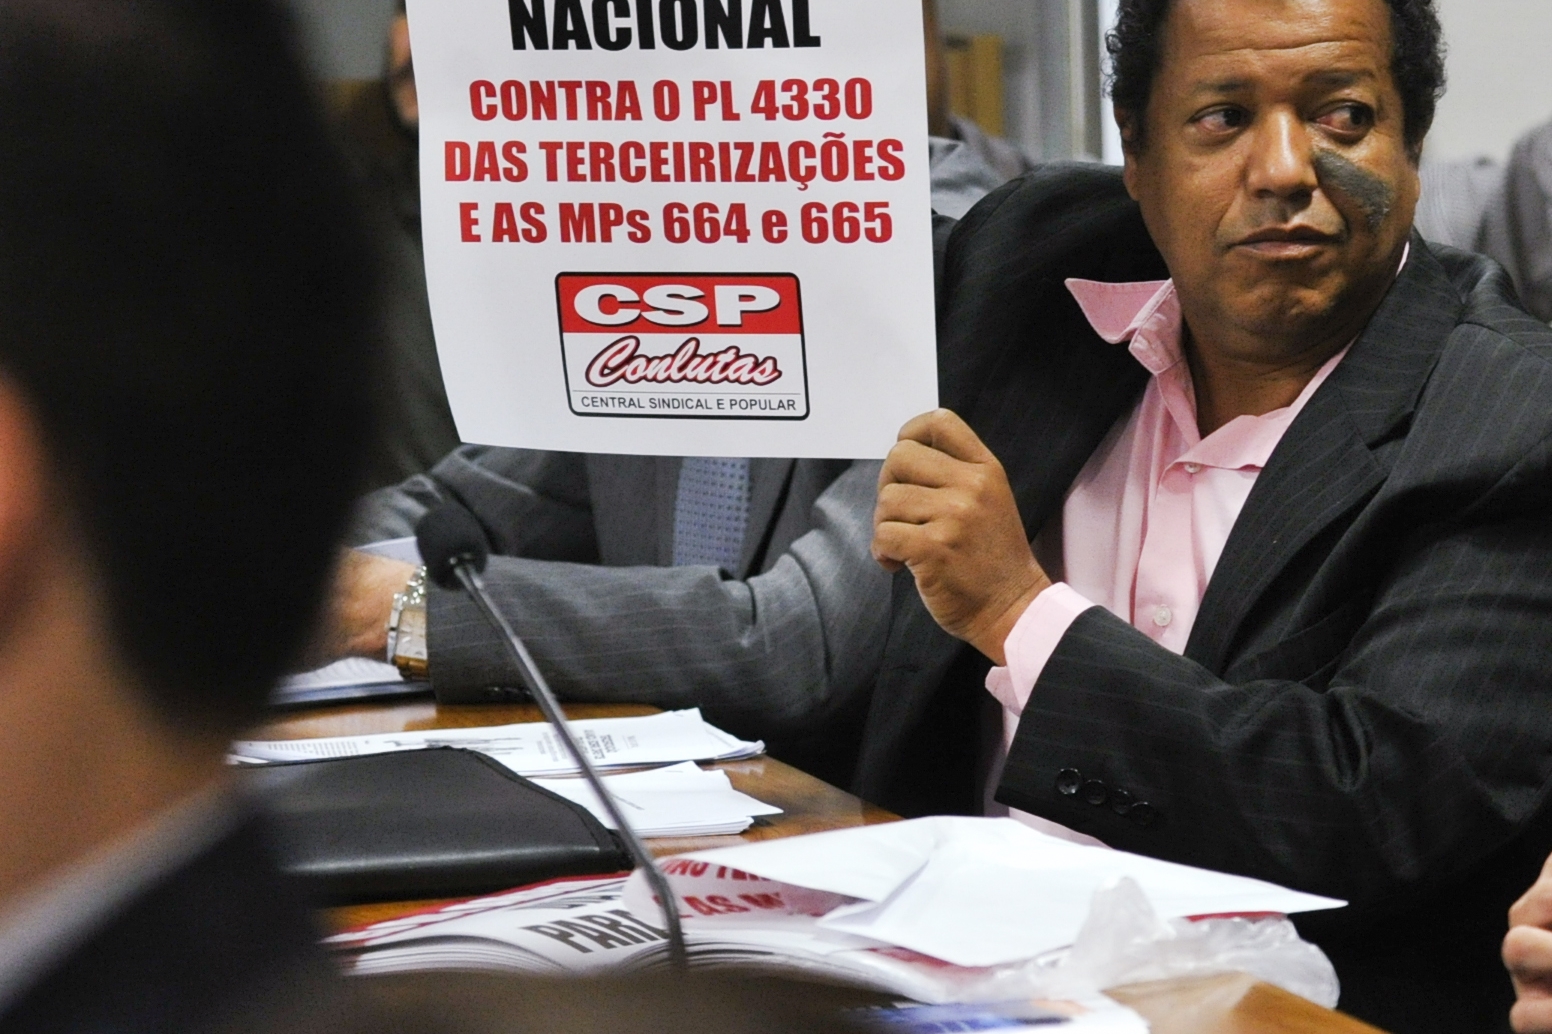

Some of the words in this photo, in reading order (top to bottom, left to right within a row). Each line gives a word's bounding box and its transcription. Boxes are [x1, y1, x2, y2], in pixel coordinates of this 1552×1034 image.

[468, 79, 643, 122] CONTRA
[652, 79, 681, 122] O
[692, 79, 741, 121] PL
[750, 76, 873, 121] 4330
[444, 139, 529, 183] DAS
[539, 131, 906, 191] TERCEIRIZAÇÕES
[459, 202, 482, 243] E
[491, 201, 547, 244] AS
[558, 202, 652, 244] MPs
[662, 201, 751, 244] 664
[761, 209, 789, 244] e
[800, 200, 893, 244] 665
[573, 283, 781, 327] CSP
[585, 335, 783, 388] Conlutas
[581, 396, 646, 409] CENTRAL
[649, 397, 713, 410] SINDICAL
[717, 398, 725, 410] E
[730, 398, 797, 411] POPULAR
